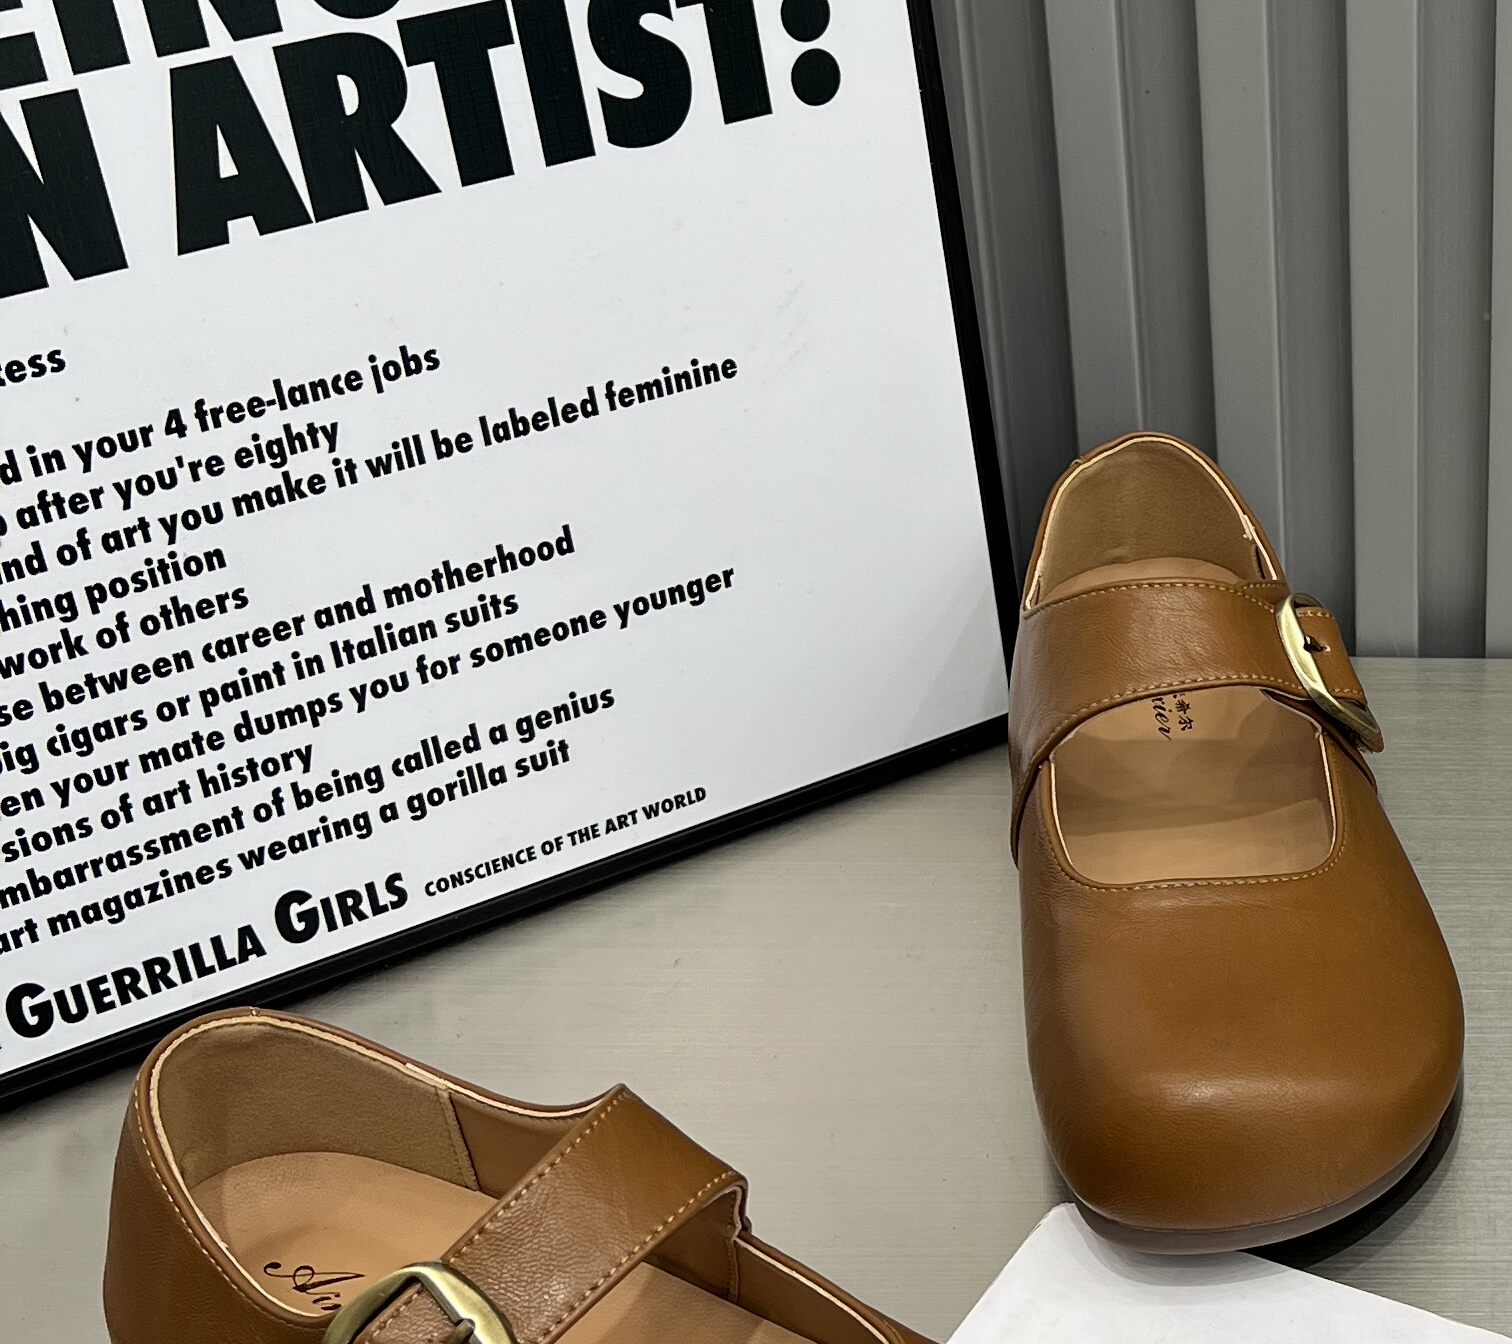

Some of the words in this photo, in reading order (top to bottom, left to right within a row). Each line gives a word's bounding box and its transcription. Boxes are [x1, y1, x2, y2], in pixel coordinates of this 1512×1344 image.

[0, 349, 66, 387] ess
[25, 444, 67, 478] in
[71, 423, 154, 474] your
[164, 407, 188, 439] 4
[194, 369, 364, 433] free-lance
[367, 344, 441, 395] jobs
[0, 539, 49, 586] nd
[56, 526, 92, 567] of
[101, 516, 152, 554] art
[157, 501, 224, 546] you
[231, 470, 327, 518] make
[331, 457, 358, 489] it
[364, 433, 427, 479] will
[430, 428, 474, 461] be
[478, 385, 600, 447] labeled
[604, 358, 738, 412] feminine
[15, 486, 105, 530] after
[111, 454, 226, 512] you're
[234, 421, 339, 469] eighty
[0, 627, 90, 680] work
[95, 610, 131, 650] of
[139, 587, 249, 636] others
[37, 649, 195, 713] between
[201, 614, 306, 664] career
[313, 583, 377, 630] and
[382, 523, 575, 609] motherhood
[84, 548, 227, 616] position
[0, 740, 40, 775] ig
[46, 709, 148, 758] cigars
[156, 694, 191, 723] or
[198, 660, 287, 718] paint
[290, 650, 326, 681] in
[329, 619, 438, 669] Italian
[444, 593, 519, 634] suits
[49, 758, 130, 809] your
[138, 730, 226, 774] mate
[233, 692, 344, 743] dumps
[348, 670, 410, 714] you
[415, 653, 461, 685] for
[469, 609, 607, 669] someone
[612, 567, 735, 630] younger
[100, 792, 134, 830] of
[142, 779, 193, 817] art
[196, 743, 313, 799] history
[252, 786, 286, 823] of
[290, 764, 385, 811] being
[391, 722, 482, 777] called
[488, 723, 509, 746] a
[515, 688, 615, 744] genius
[46, 858, 233, 937] magazines
[236, 810, 373, 871] wearing
[378, 801, 400, 824] a
[406, 762, 508, 822] gorilla
[514, 739, 570, 778] suit
[5, 924, 267, 1039] GUERRILLA
[274, 872, 408, 944] GIRLS
[424, 845, 538, 897] CONSCIENCE
[540, 835, 564, 856] OF
[567, 823, 601, 846] THE
[605, 809, 638, 835] ART
[641, 787, 707, 820] WORLD
